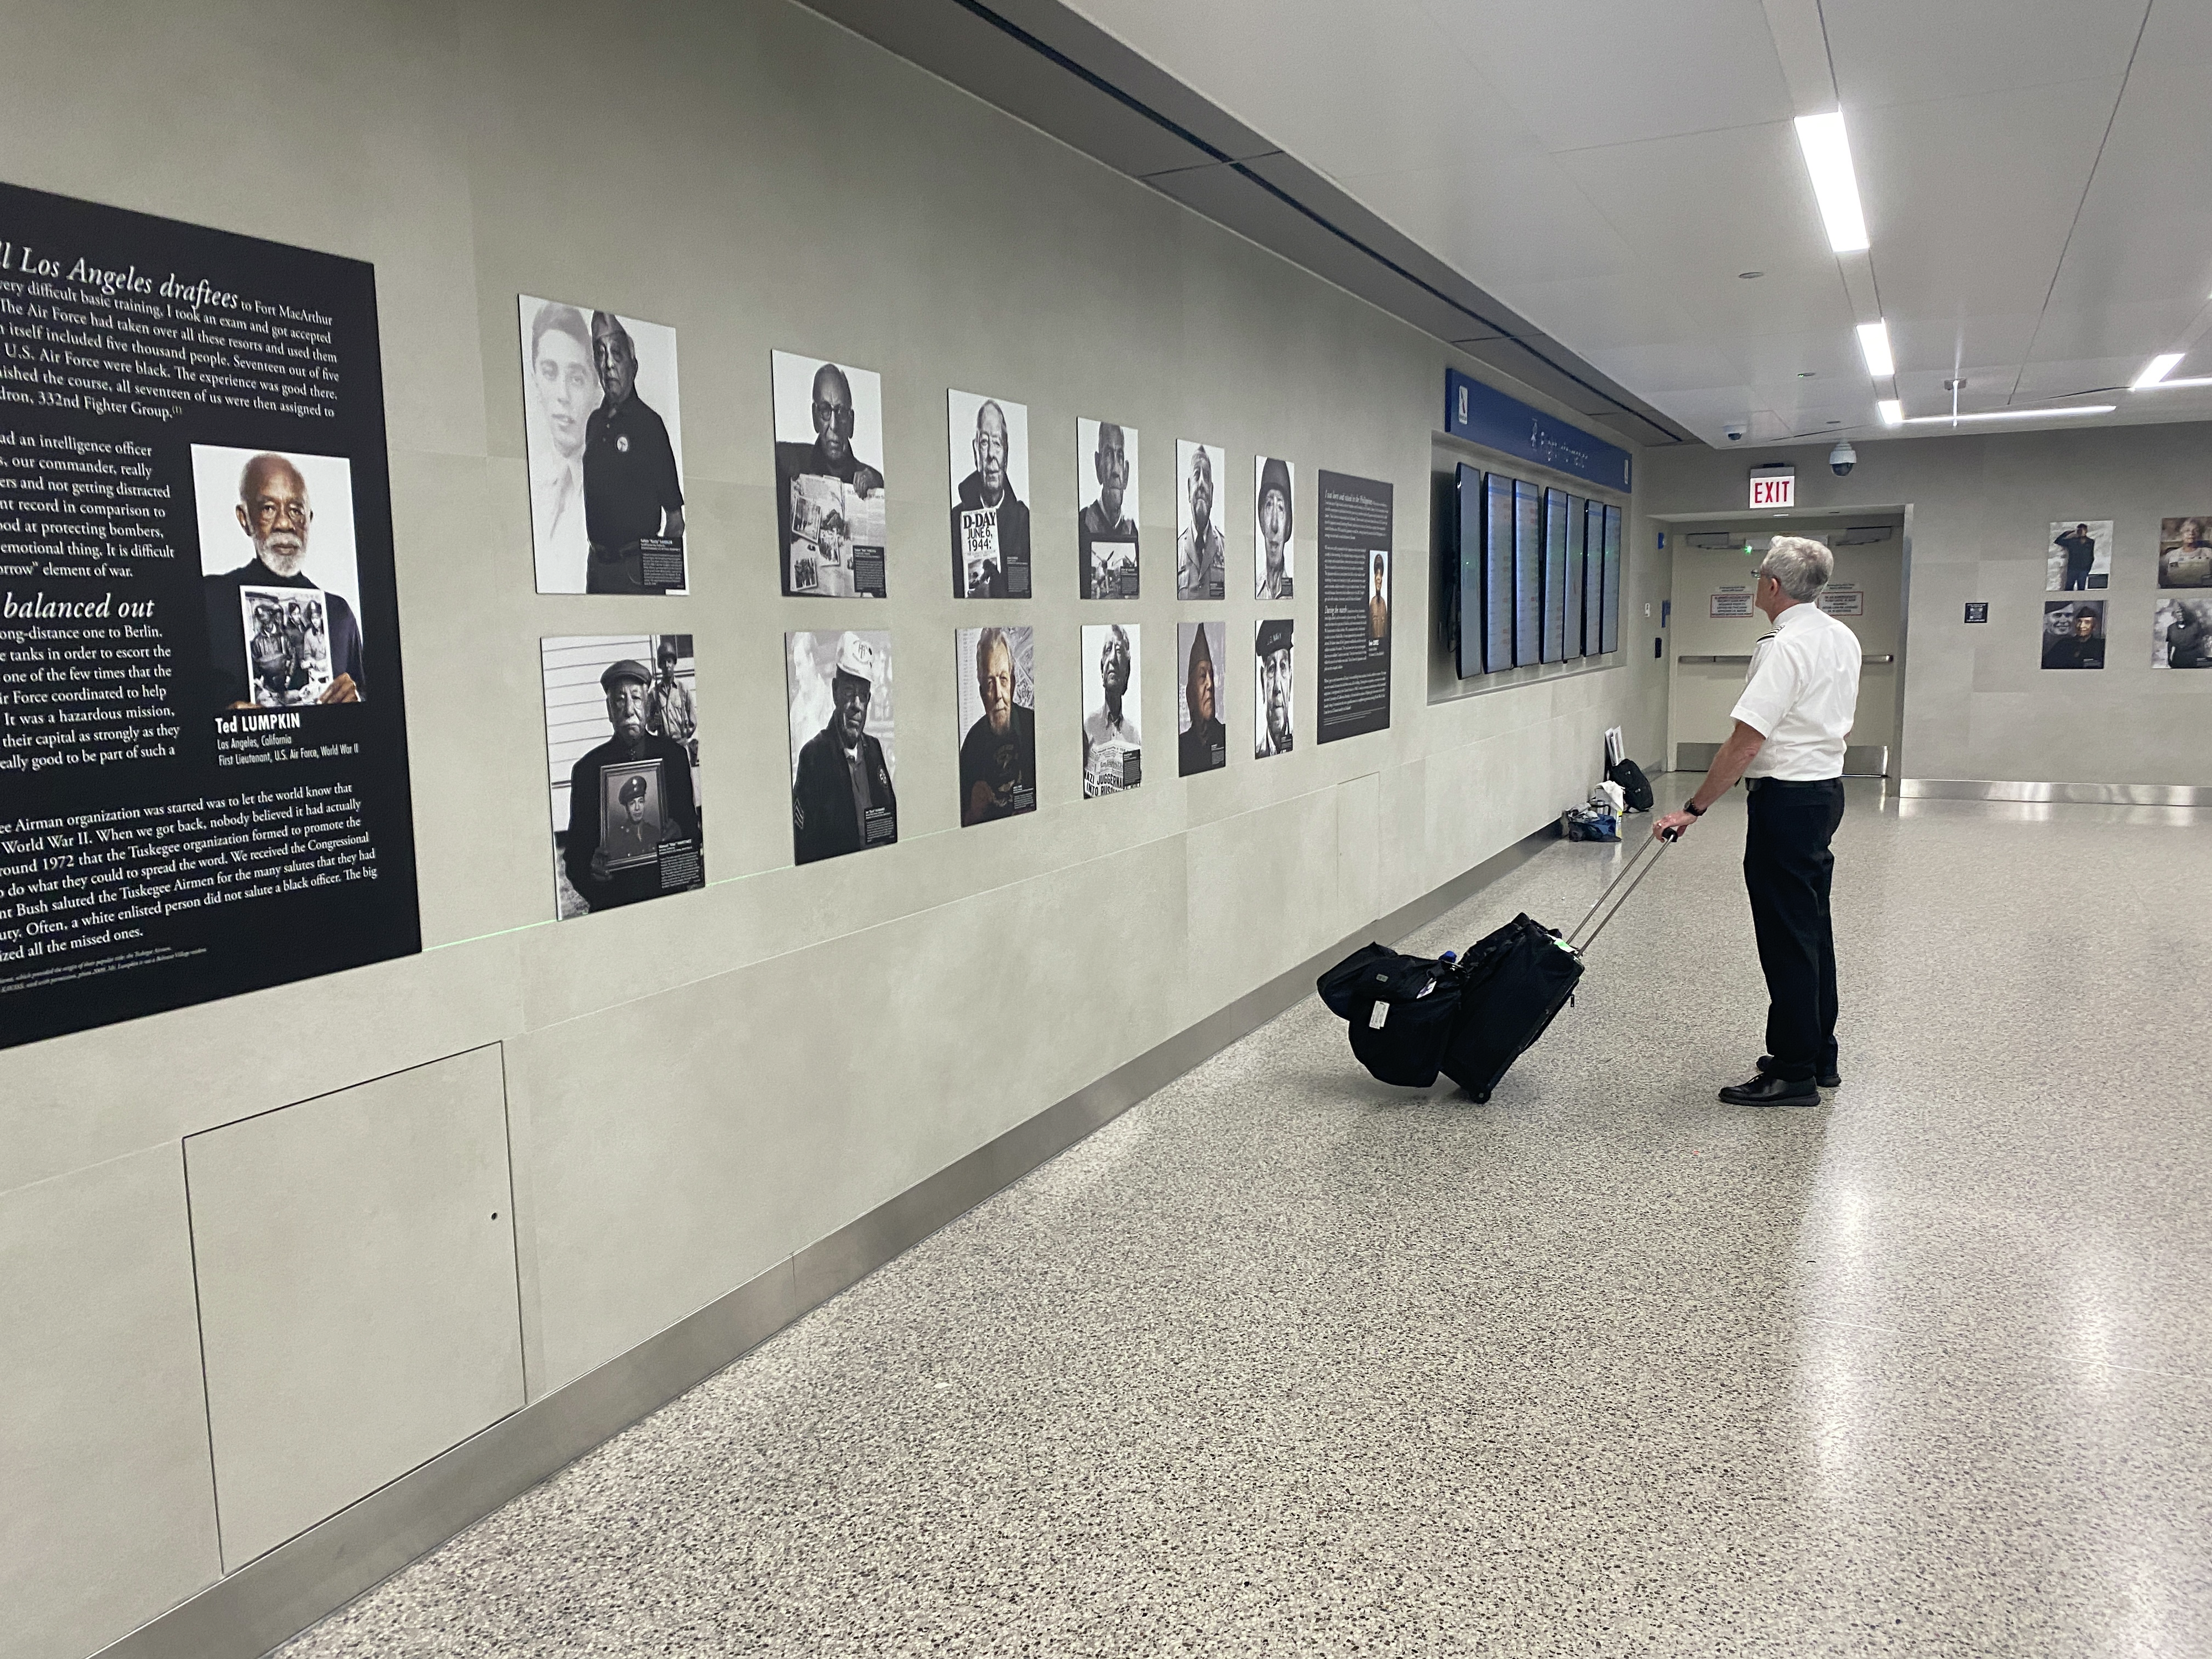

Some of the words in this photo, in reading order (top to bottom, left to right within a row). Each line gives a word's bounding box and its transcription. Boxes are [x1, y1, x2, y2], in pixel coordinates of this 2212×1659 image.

[18, 246, 60, 279] Los
[65, 257, 153, 295] Angeles
[159, 272, 239, 310] draftees
[240, 300, 253, 312] to
[254, 299, 277, 317] Fort
[278, 304, 333, 326] MacArthur
[26, 301, 49, 320] Air
[51, 305, 88, 326] Force
[89, 311, 116, 330] had
[117, 316, 150, 336] taken
[152, 326, 179, 340] over
[180, 326, 196, 342] all
[197, 328, 227, 347] these
[227, 337, 264, 353] resorts
[265, 341, 285, 356] and
[286, 346, 311, 360] used
[311, 347, 338, 364] them
[9, 321, 45, 341] itself
[45, 327, 103, 349] included
[106, 335, 129, 353] five
[131, 339, 187, 361] thousand
[233, 353, 287, 374] Seventeen
[288, 366, 307, 378] out
[308, 365, 321, 380] of
[322, 366, 340, 383] five
[38, 390, 82, 409] 332nd
[83, 395, 128, 416] Fighter
[42, 368, 65, 386] the
[116, 378, 132, 394] all
[134, 384, 193, 401] seventeen
[194, 388, 208, 403] of
[208, 393, 223, 405] us
[223, 395, 251, 408] were
[253, 395, 278, 411] then
[277, 401, 322, 419] assigned
[324, 407, 336, 418] to
[19, 435, 37, 447] an
[39, 434, 112, 455] intelligence
[114, 440, 153, 457] officer
[11, 456, 36, 469] our
[120, 462, 153, 481] really
[1755, 481, 1790, 503] EXIT
[963, 512, 996, 529] D-DAY
[968, 527, 985, 539] JUNE
[985, 526, 993, 539] 6,
[0, 539, 65, 556] emotional
[105, 542, 117, 557] It
[118, 543, 129, 557] is
[131, 542, 176, 559] difficult
[968, 538, 992, 551] 1944:
[3, 591, 112, 619] balanced
[117, 599, 156, 618] out
[82, 628, 106, 639] one
[108, 628, 122, 639] to
[2, 672, 28, 684] one
[29, 667, 45, 682] of
[46, 667, 67, 682] the
[69, 666, 93, 681] few
[93, 666, 126, 680] times
[127, 664, 152, 679] that
[153, 663, 173, 678] the
[3, 711, 16, 727] It
[19, 714, 45, 726] was
[48, 713, 56, 724] a
[58, 706, 123, 723] hazardous
[214, 714, 239, 735] Ted
[241, 712, 301, 733] LUMPKIN
[2, 733, 33, 748] their
[35, 728, 76, 749] capital
[78, 732, 91, 744] as
[93, 724, 140, 744] strongly
[142, 728, 155, 738] as
[155, 722, 181, 739] they
[217, 738, 231, 751] Los
[230, 735, 260, 752] Angeles,
[260, 733, 293, 747] California
[30, 750, 64, 771] good
[66, 754, 80, 765] to
[81, 748, 97, 763] be
[99, 750, 124, 766] part
[126, 744, 139, 759] of
[139, 743, 167, 758] such
[168, 746, 176, 756] a
[218, 754, 234, 766] First
[274, 748, 289, 762] U.S.
[289, 748, 300, 760] Air
[320, 743, 340, 757] World
[339, 743, 353, 755] War
[353, 742, 359, 754] II
[1087, 782, 1098, 796] INTO
[14, 817, 65, 833] Airman
[66, 807, 142, 829] organization
[142, 806, 165, 817] was
[166, 797, 206, 815] started
[205, 799, 226, 810] was
[227, 797, 241, 807] to
[241, 792, 256, 806] let
[257, 790, 274, 804] the
[274, 786, 305, 801] world
[305, 785, 333, 798] know
[333, 782, 353, 795] that
[0, 836, 45, 854] World
[46, 834, 75, 849] War
[76, 831, 93, 846] II.
[95, 827, 134, 843] When
[135, 827, 153, 838] we
[155, 824, 176, 839] got
[210, 811, 251, 829] nobody
[252, 805, 294, 823] believed
[295, 806, 304, 818] it
[305, 802, 325, 816] had
[325, 797, 362, 813] actually
[7, 882, 25, 898] do
[27, 878, 59, 894] what
[61, 874, 88, 890] they
[90, 867, 124, 885] could
[126, 869, 139, 879] to
[140, 858, 177, 880] spread
[178, 857, 197, 872] the
[197, 852, 229, 868] word.
[229, 849, 248, 863] We
[249, 842, 289, 860] received
[290, 841, 306, 854] the
[307, 831, 371, 852] Congressional
[25, 919, 69, 936] Often,
[70, 919, 79, 929] a
[81, 911, 116, 927] white
[117, 900, 163, 921] enlisted
[164, 898, 202, 916] person
[203, 890, 222, 906] did
[223, 891, 243, 902] not
[243, 884, 274, 899] salute
[274, 884, 283, 893] a
[282, 875, 310, 892] black
[310, 872, 342, 887] officer.
[342, 868, 362, 881] The
[362, 865, 379, 880] big
